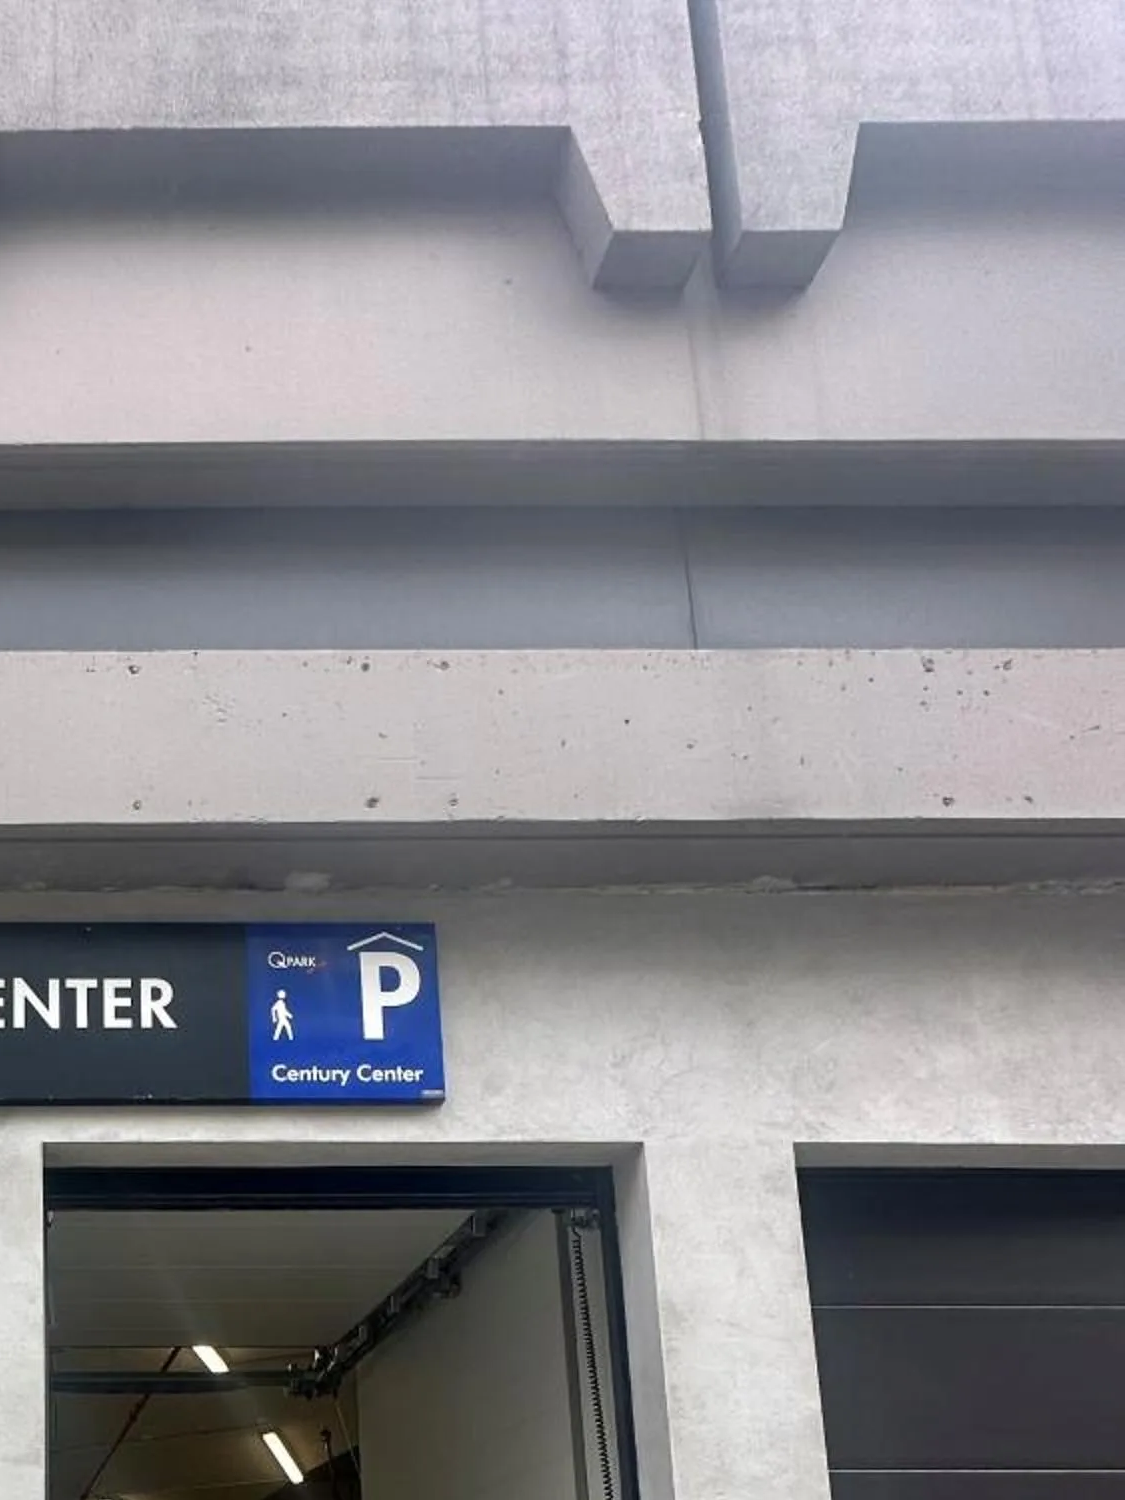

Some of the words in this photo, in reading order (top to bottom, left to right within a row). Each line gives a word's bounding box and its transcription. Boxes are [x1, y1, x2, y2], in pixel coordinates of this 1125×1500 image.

[359, 951, 421, 1041] P
[271, 1063, 351, 1087] Century
[356, 1064, 424, 1083] Center
